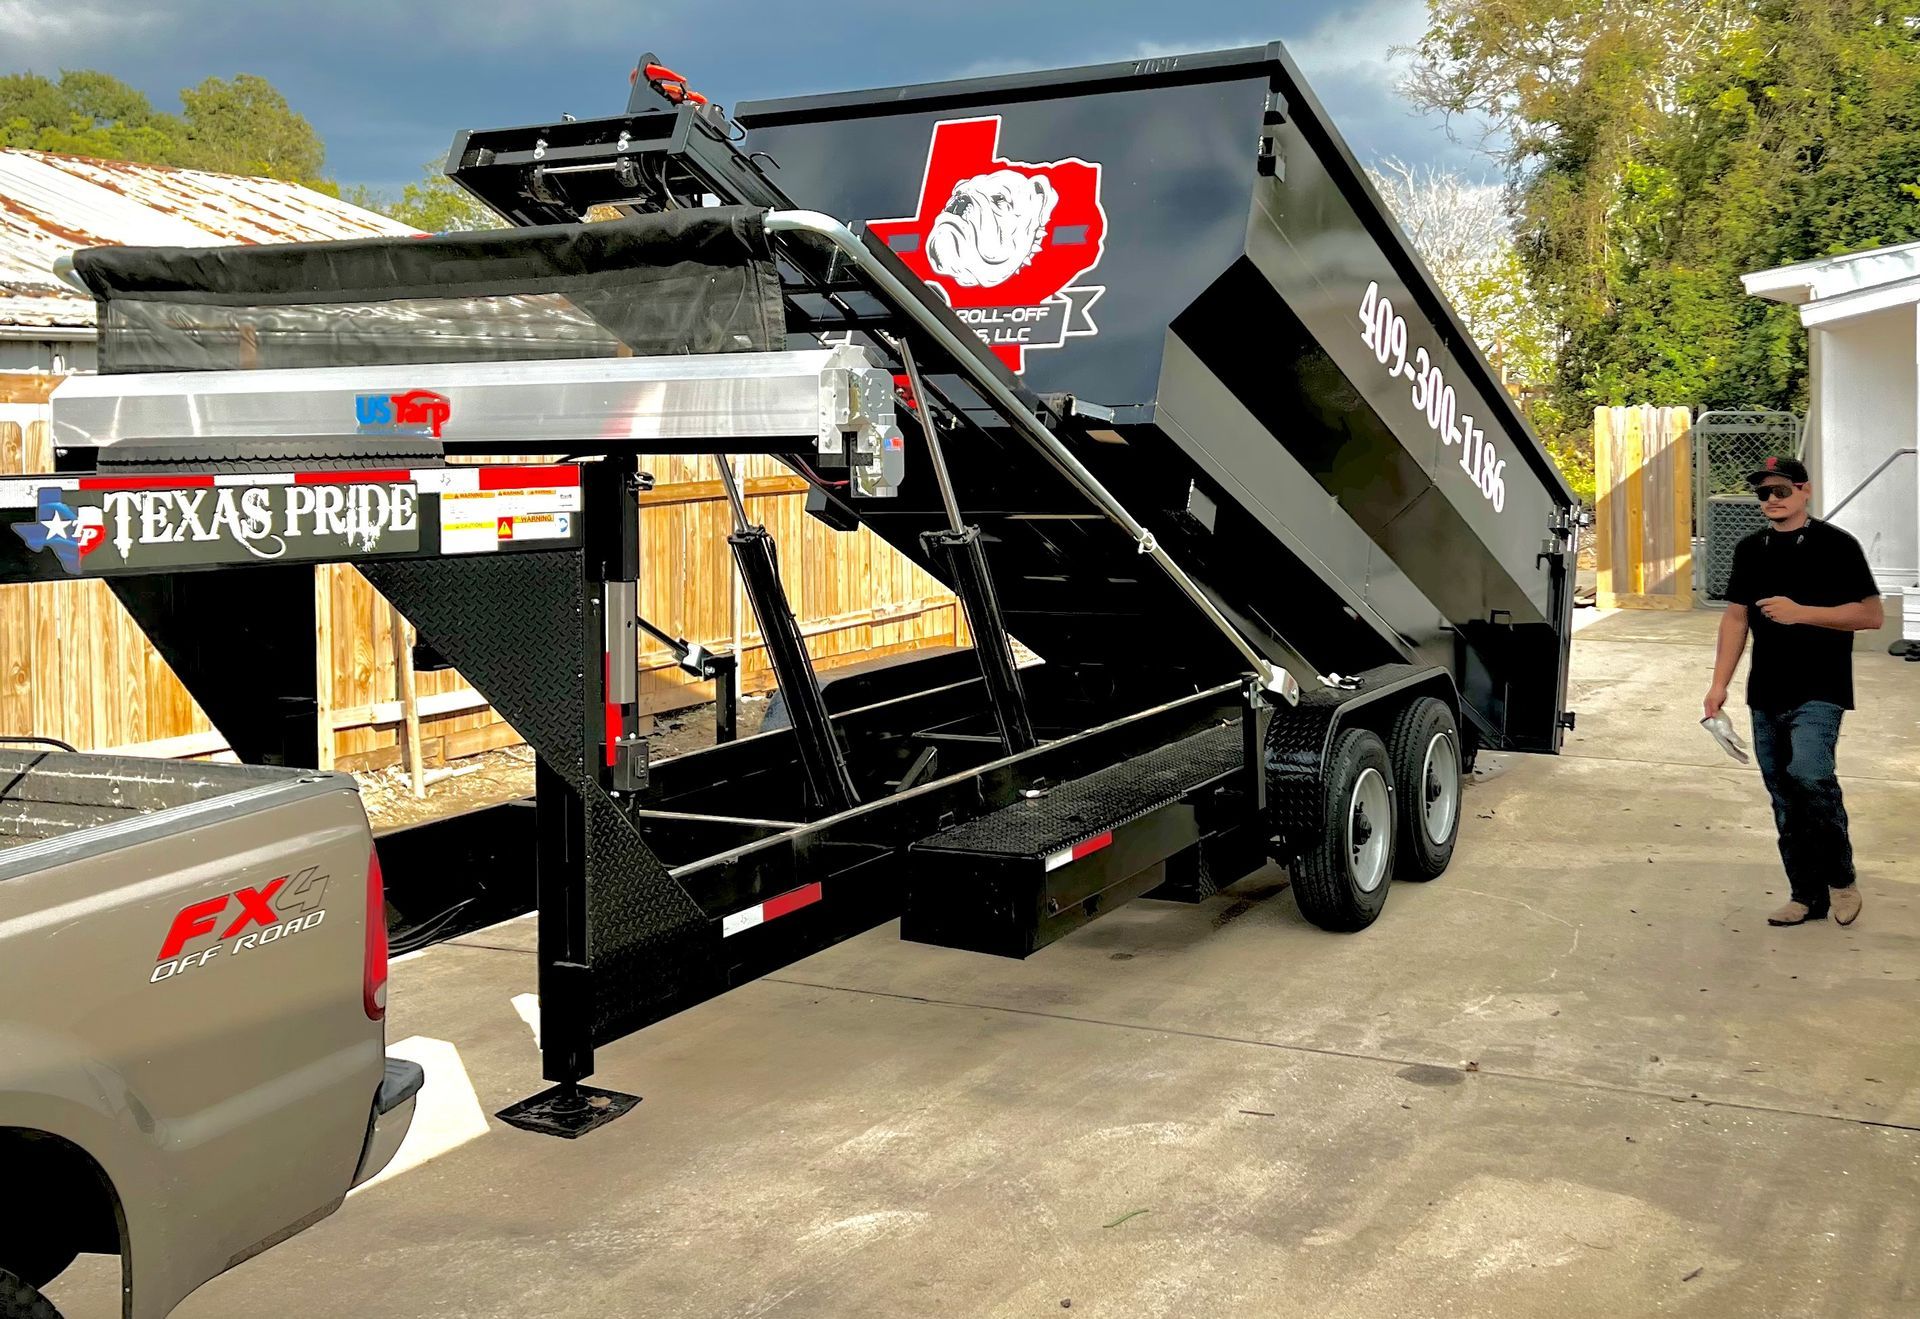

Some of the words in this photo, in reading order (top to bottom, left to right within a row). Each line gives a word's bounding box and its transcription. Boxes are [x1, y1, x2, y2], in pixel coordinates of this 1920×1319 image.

[955, 307, 1050, 323] ROLL-OFF
[994, 327, 1031, 342] LLC
[1359, 280, 1506, 513] 409-300-1186
[103, 486, 286, 561] TEXAS
[284, 483, 417, 552] PRIDE
[149, 943, 224, 984] OFF
[231, 909, 326, 956] ROAD
[156, 865, 330, 962] FX4
